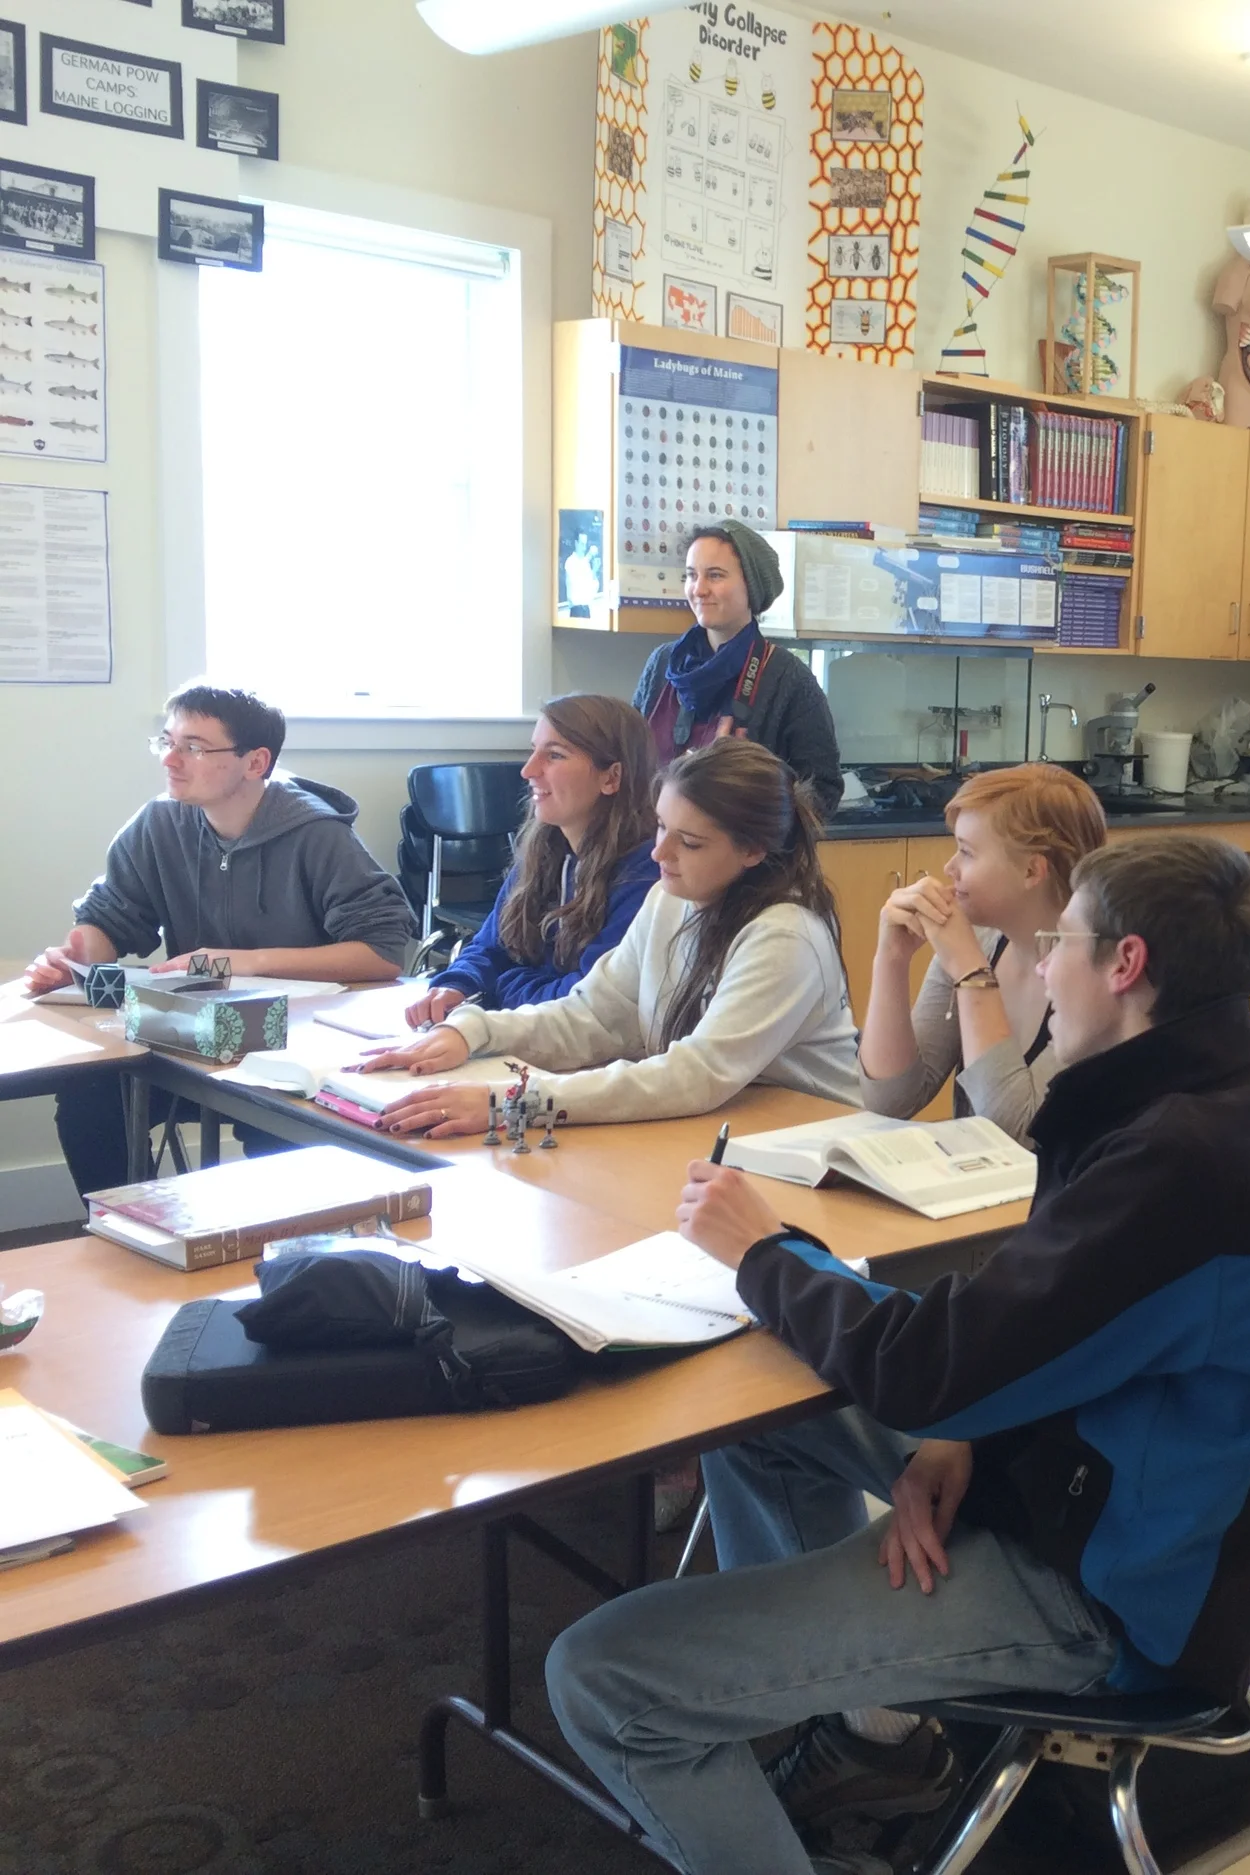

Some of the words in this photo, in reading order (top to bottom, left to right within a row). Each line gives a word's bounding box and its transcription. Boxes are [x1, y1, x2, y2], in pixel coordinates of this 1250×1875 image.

[724, 3, 787, 47] Collapse
[699, 24, 761, 61] Disorder
[61, 52, 121, 76] GERMAN
[126, 66, 159, 84] POW
[86, 77, 138, 98] CAMPS:
[54, 89, 100, 110] MAINE
[105, 99, 168, 123] LOGGING
[653, 357, 700, 376] Ladybugs
[700, 364, 711, 376] of
[713, 366, 743, 381] Maine
[747, 656, 760, 681] EOS
[193, 1250, 217, 1260] SAXON
